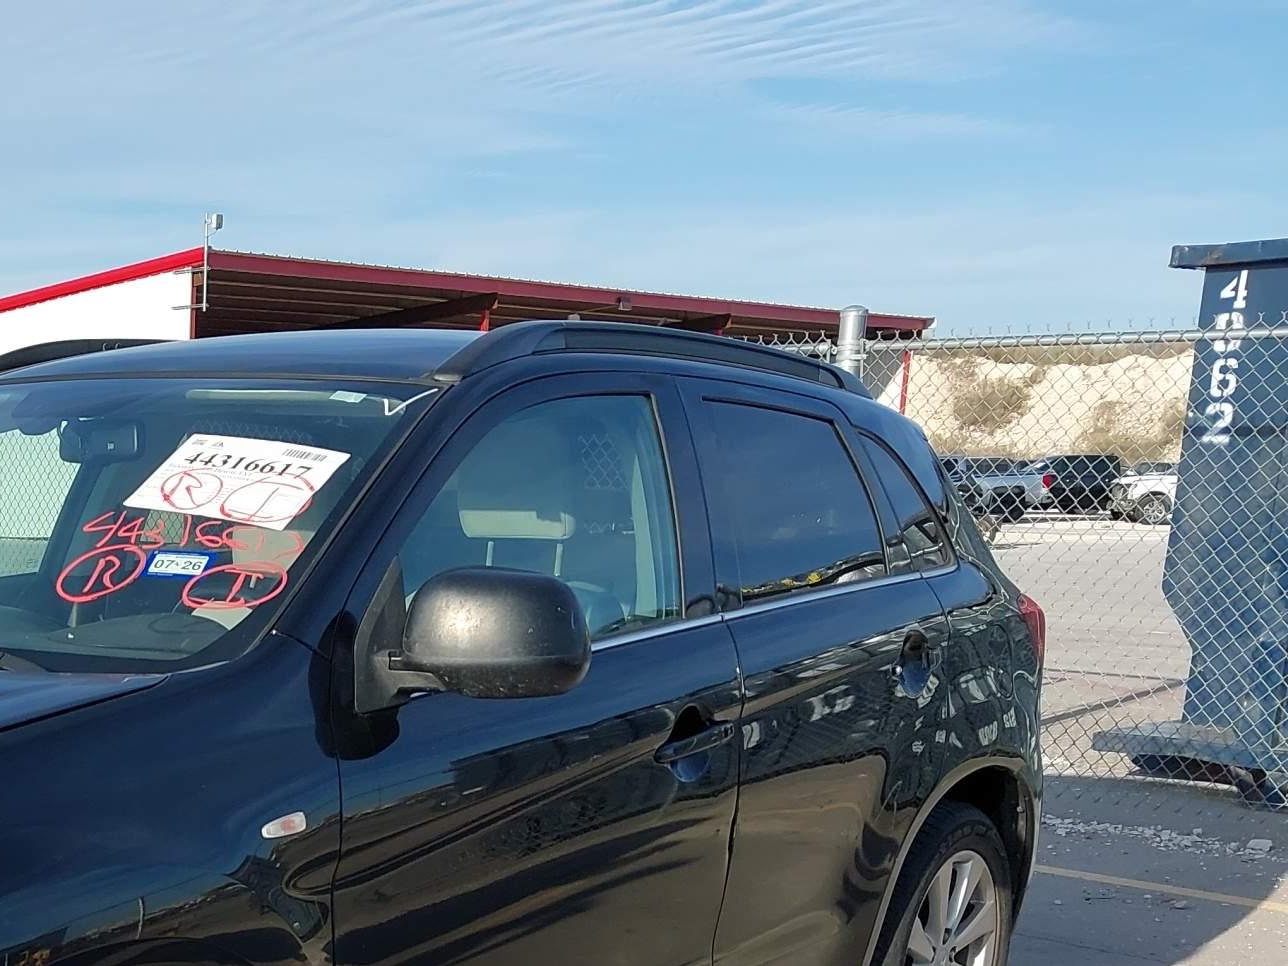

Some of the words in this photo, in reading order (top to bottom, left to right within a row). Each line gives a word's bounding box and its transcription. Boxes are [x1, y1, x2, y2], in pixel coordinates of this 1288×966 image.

[185, 450, 313, 479] 44316617
[153, 558, 175, 571] 07
[181, 560, 202, 572] 26
